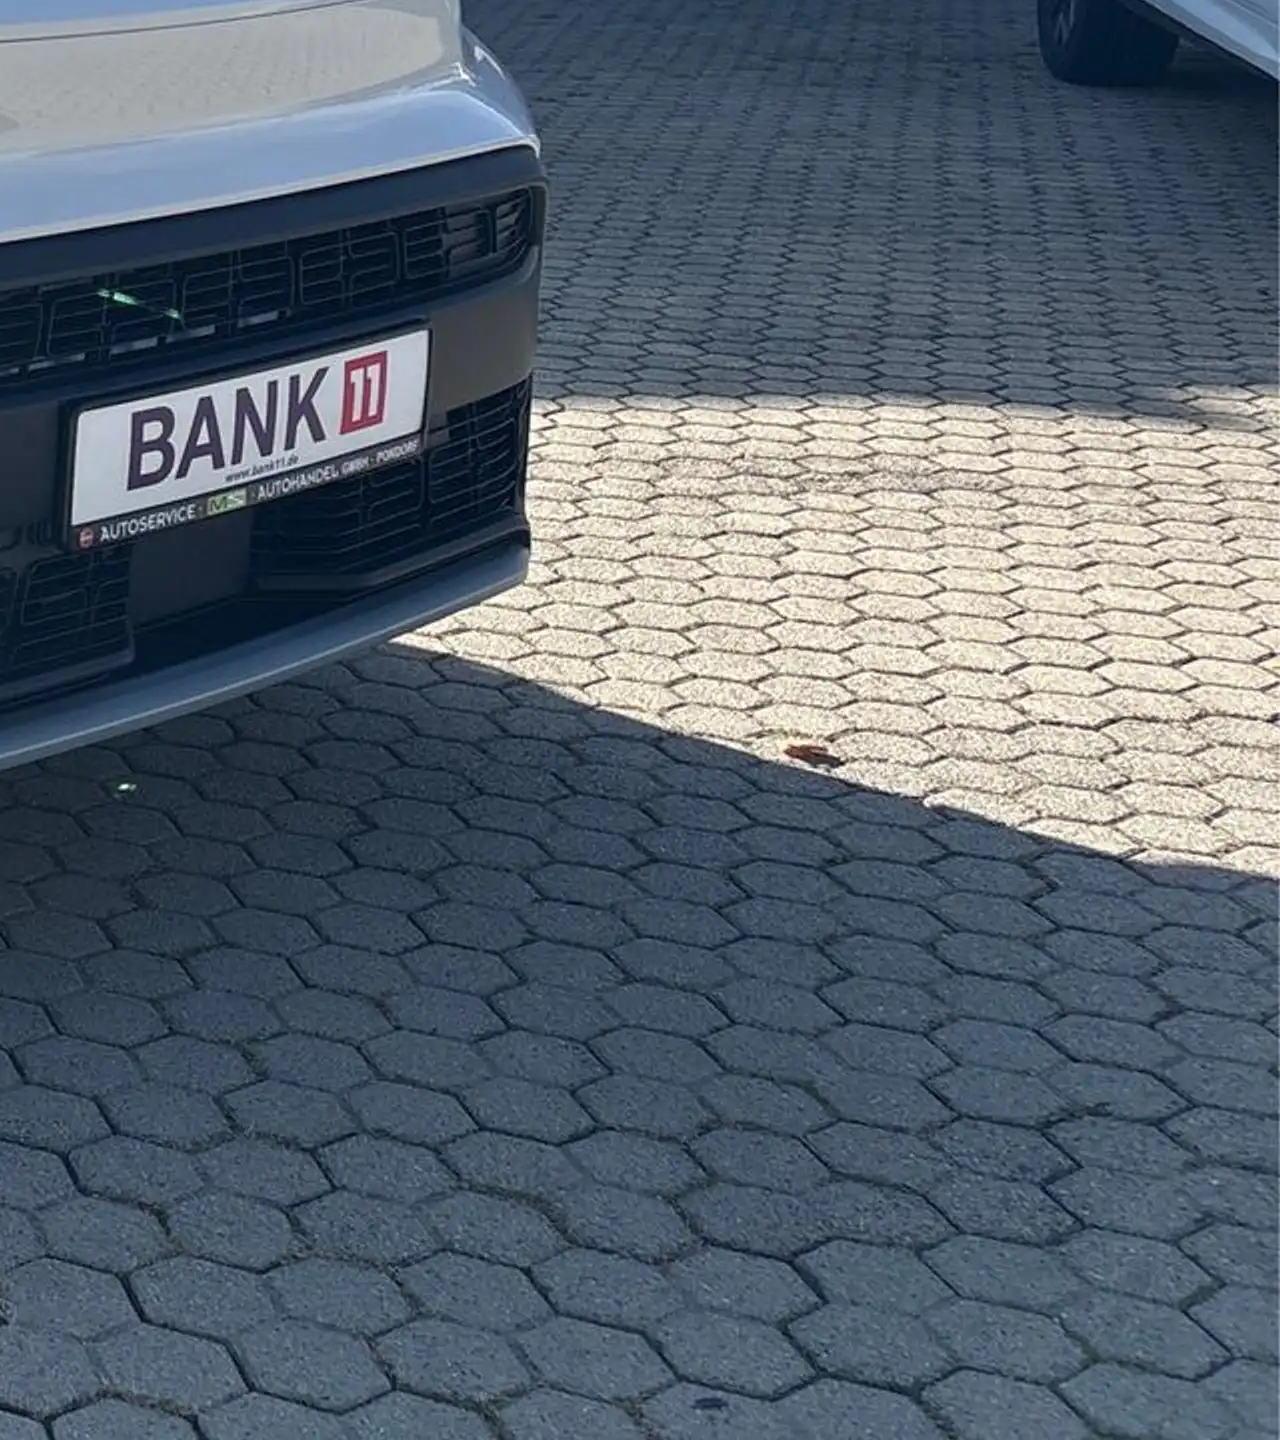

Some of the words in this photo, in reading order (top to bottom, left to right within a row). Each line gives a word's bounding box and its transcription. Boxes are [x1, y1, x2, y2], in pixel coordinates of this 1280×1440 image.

[127, 366, 330, 491] BANK
[346, 359, 384, 427] 11
[99, 503, 197, 543] AUTOSERVICE
[257, 464, 339, 501] AUTOHANDEL
